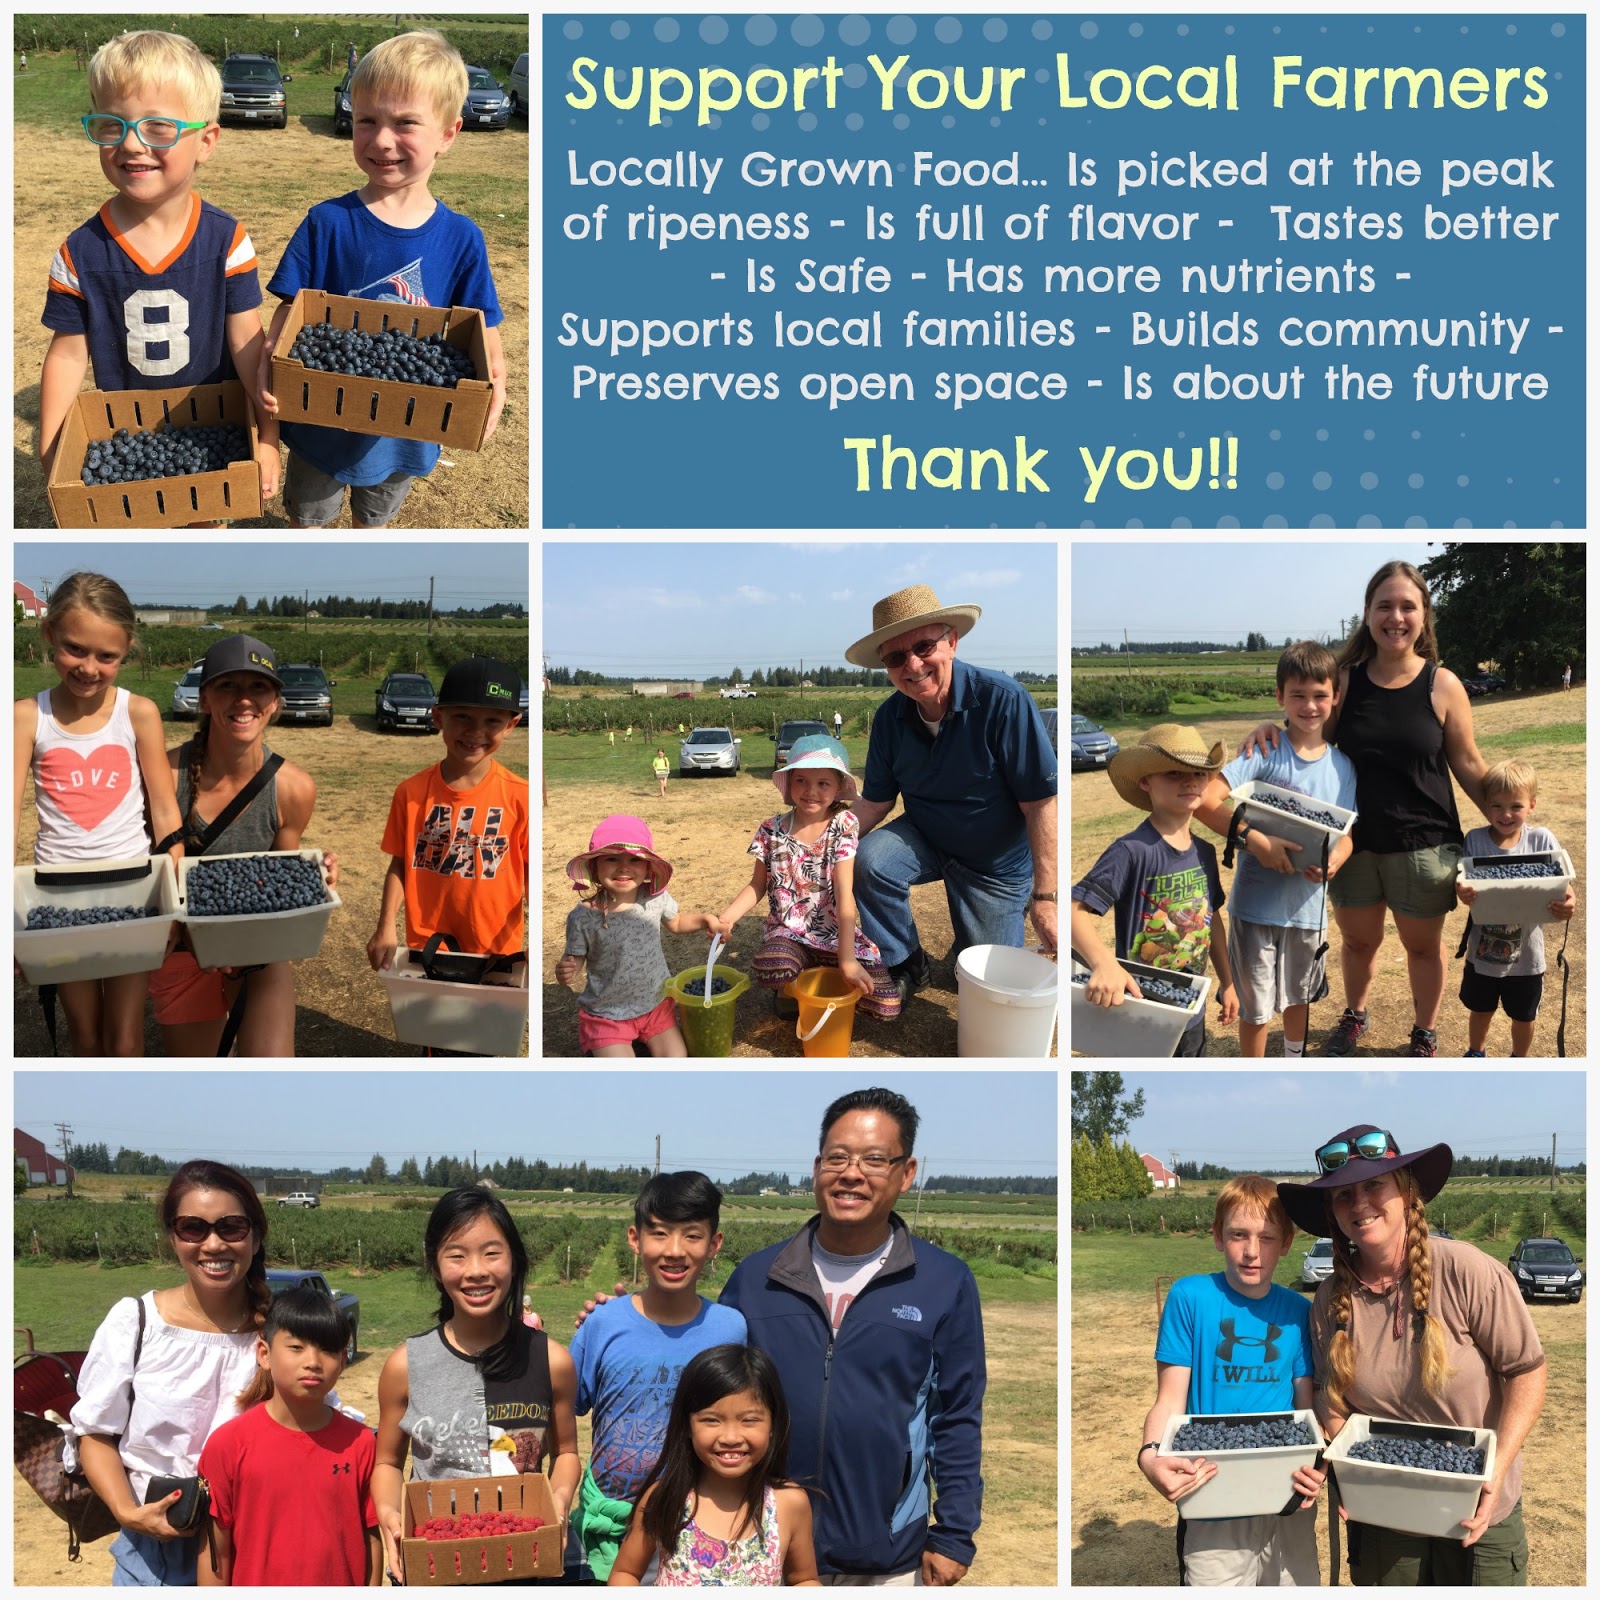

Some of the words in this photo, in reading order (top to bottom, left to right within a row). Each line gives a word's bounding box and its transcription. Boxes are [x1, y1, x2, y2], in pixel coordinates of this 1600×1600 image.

[124, 289, 190, 376] 8
[52, 768, 120, 792] LOVE
[422, 804, 504, 846] ALL
[412, 834, 510, 879] DAY
[1212, 1365, 1219, 1382] I
[1223, 1365, 1281, 1383] WILL
